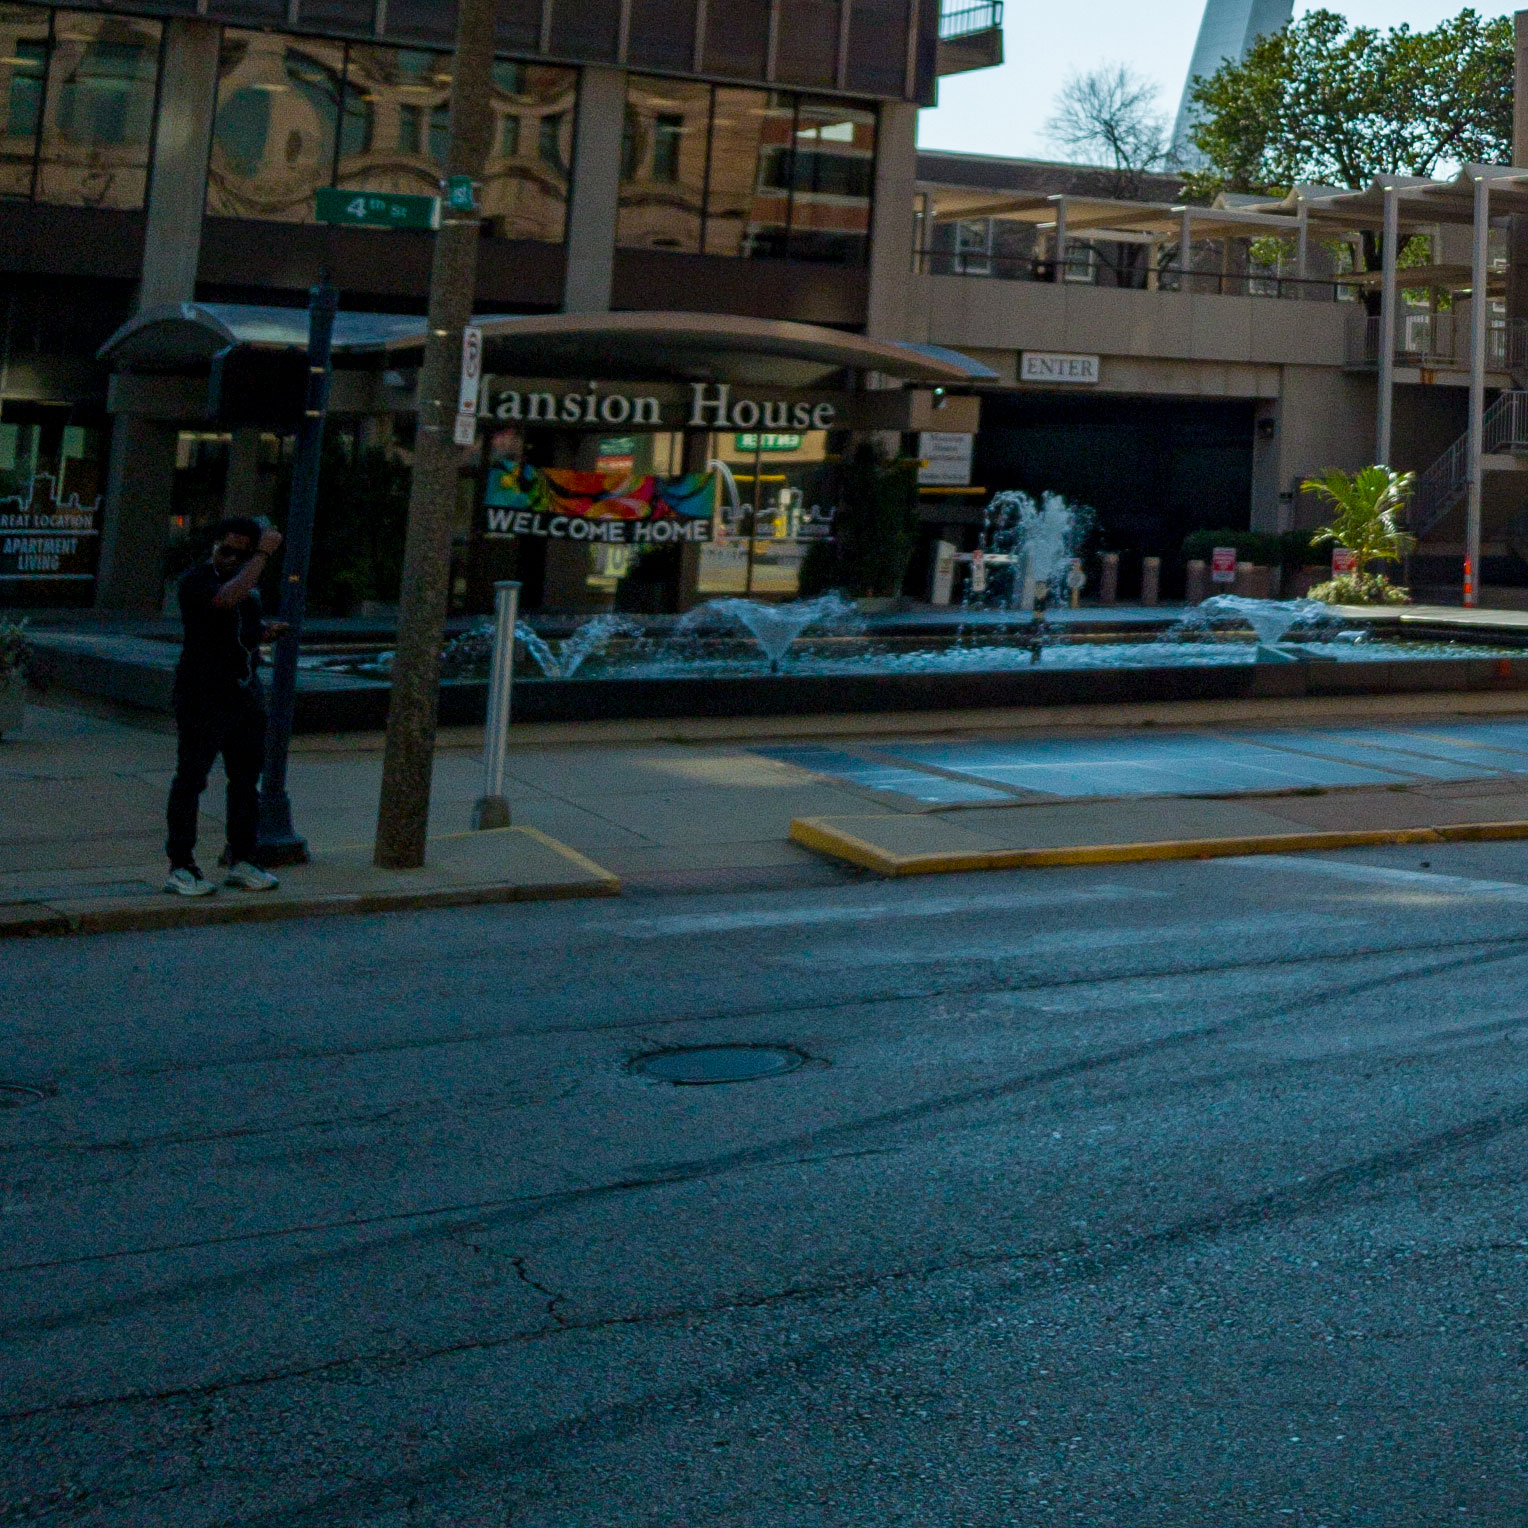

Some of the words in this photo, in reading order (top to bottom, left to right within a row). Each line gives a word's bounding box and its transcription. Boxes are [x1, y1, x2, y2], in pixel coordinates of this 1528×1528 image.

[346, 197, 386, 219] 4th
[390, 204, 407, 219] St
[1027, 356, 1093, 377] ENTER
[688, 382, 836, 429] House
[34, 514, 94, 529] LOCATION
[486, 508, 625, 542] WELCOME
[633, 520, 709, 542] HOME
[2, 537, 79, 555] APARTMENT
[18, 555, 60, 571] LIVING
